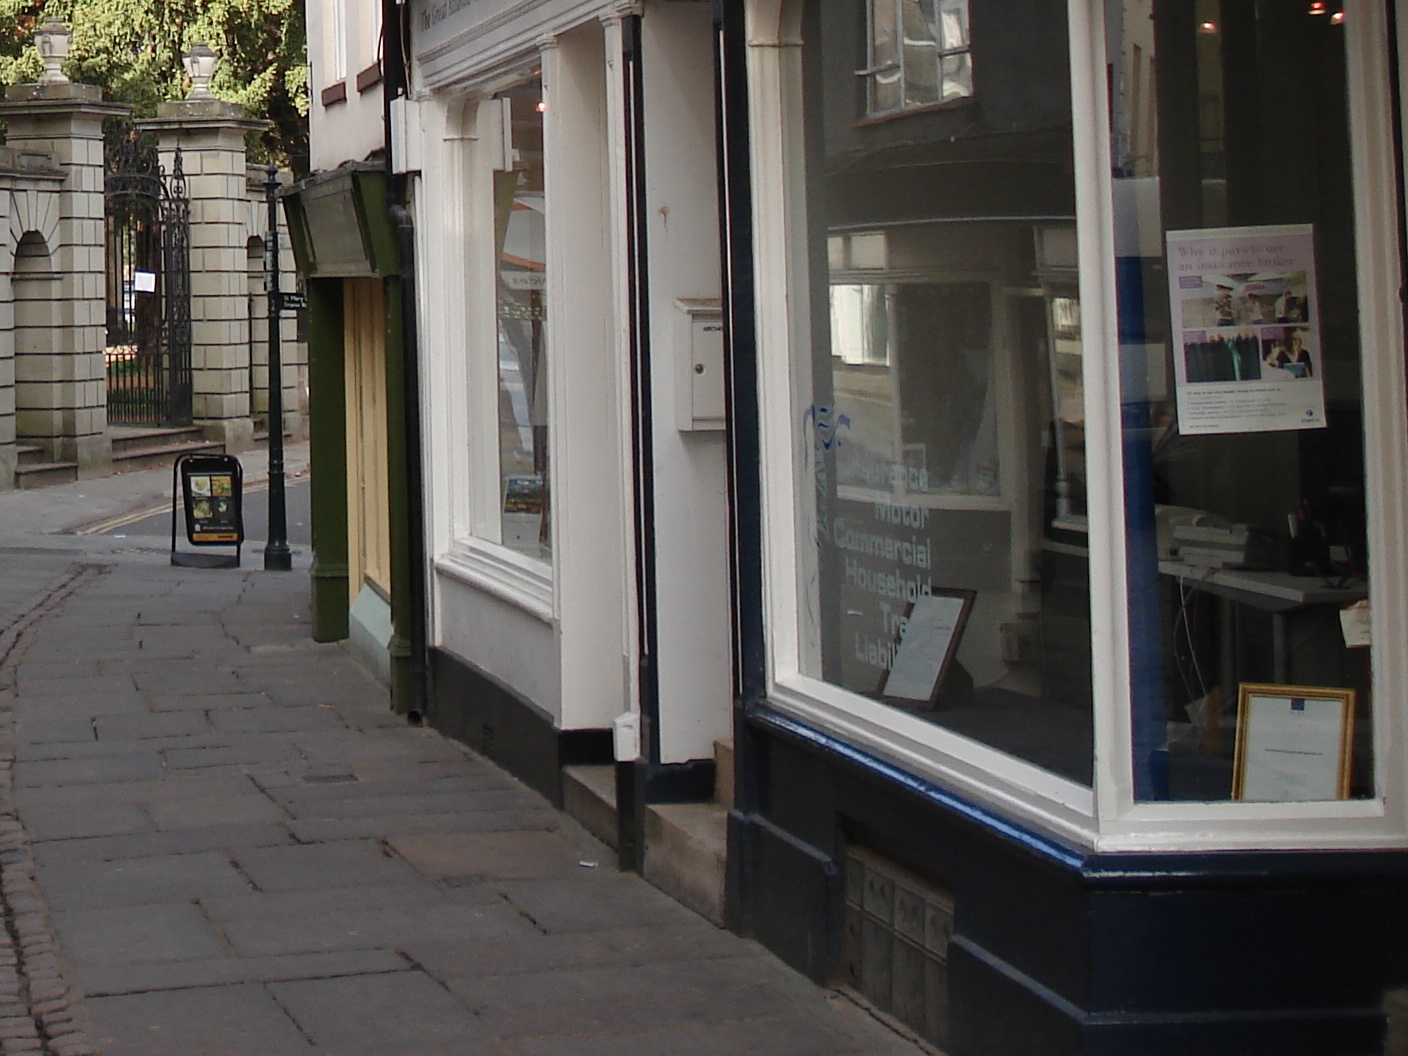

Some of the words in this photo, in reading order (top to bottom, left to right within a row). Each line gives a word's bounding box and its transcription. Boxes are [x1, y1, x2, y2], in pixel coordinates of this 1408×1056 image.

[873, 498, 929, 530] Motor
[833, 517, 931, 570] Commercial
[844, 557, 932, 604] Household
